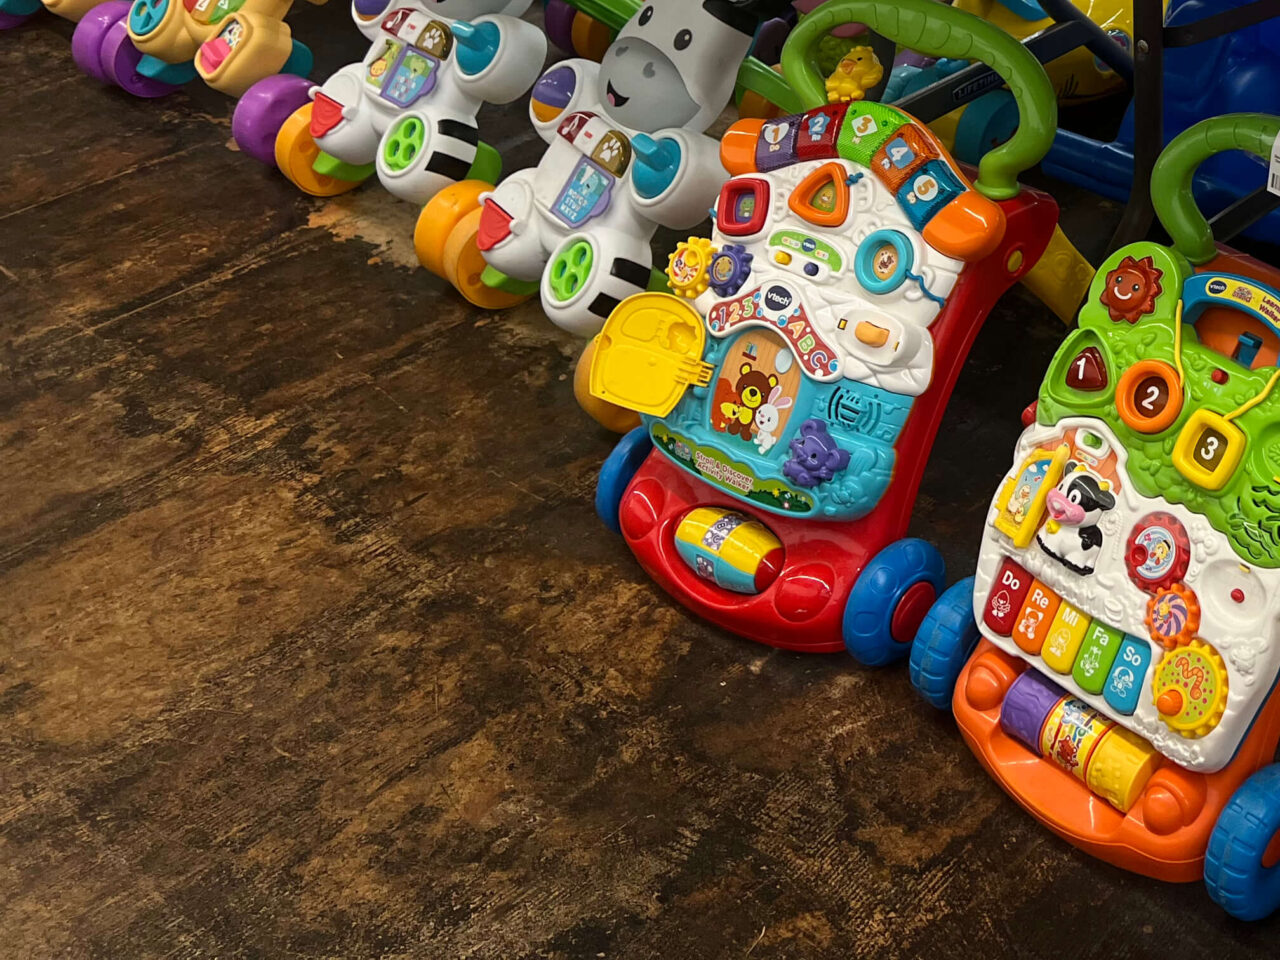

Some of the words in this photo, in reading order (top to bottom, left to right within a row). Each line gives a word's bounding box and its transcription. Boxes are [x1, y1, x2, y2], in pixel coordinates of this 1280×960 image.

[957, 72, 1000, 98] LIFETIM
[813, 116, 825, 131] 2
[856, 117, 873, 134] 3
[890, 146, 908, 162] 4
[917, 178, 936, 197] 5
[1076, 357, 1087, 380] 1
[1141, 386, 1160, 410] 2
[1200, 436, 1219, 460] 3
[695, 451, 714, 469] Stroll
[722, 464, 753, 484] Discover
[697, 461, 723, 481] Activity
[724, 475, 751, 492] Walker
[1002, 570, 1020, 590] Do
[1031, 589, 1049, 609] Re
[1062, 607, 1080, 627] Mi
[1092, 627, 1109, 646] Fa
[1123, 646, 1142, 666] So
